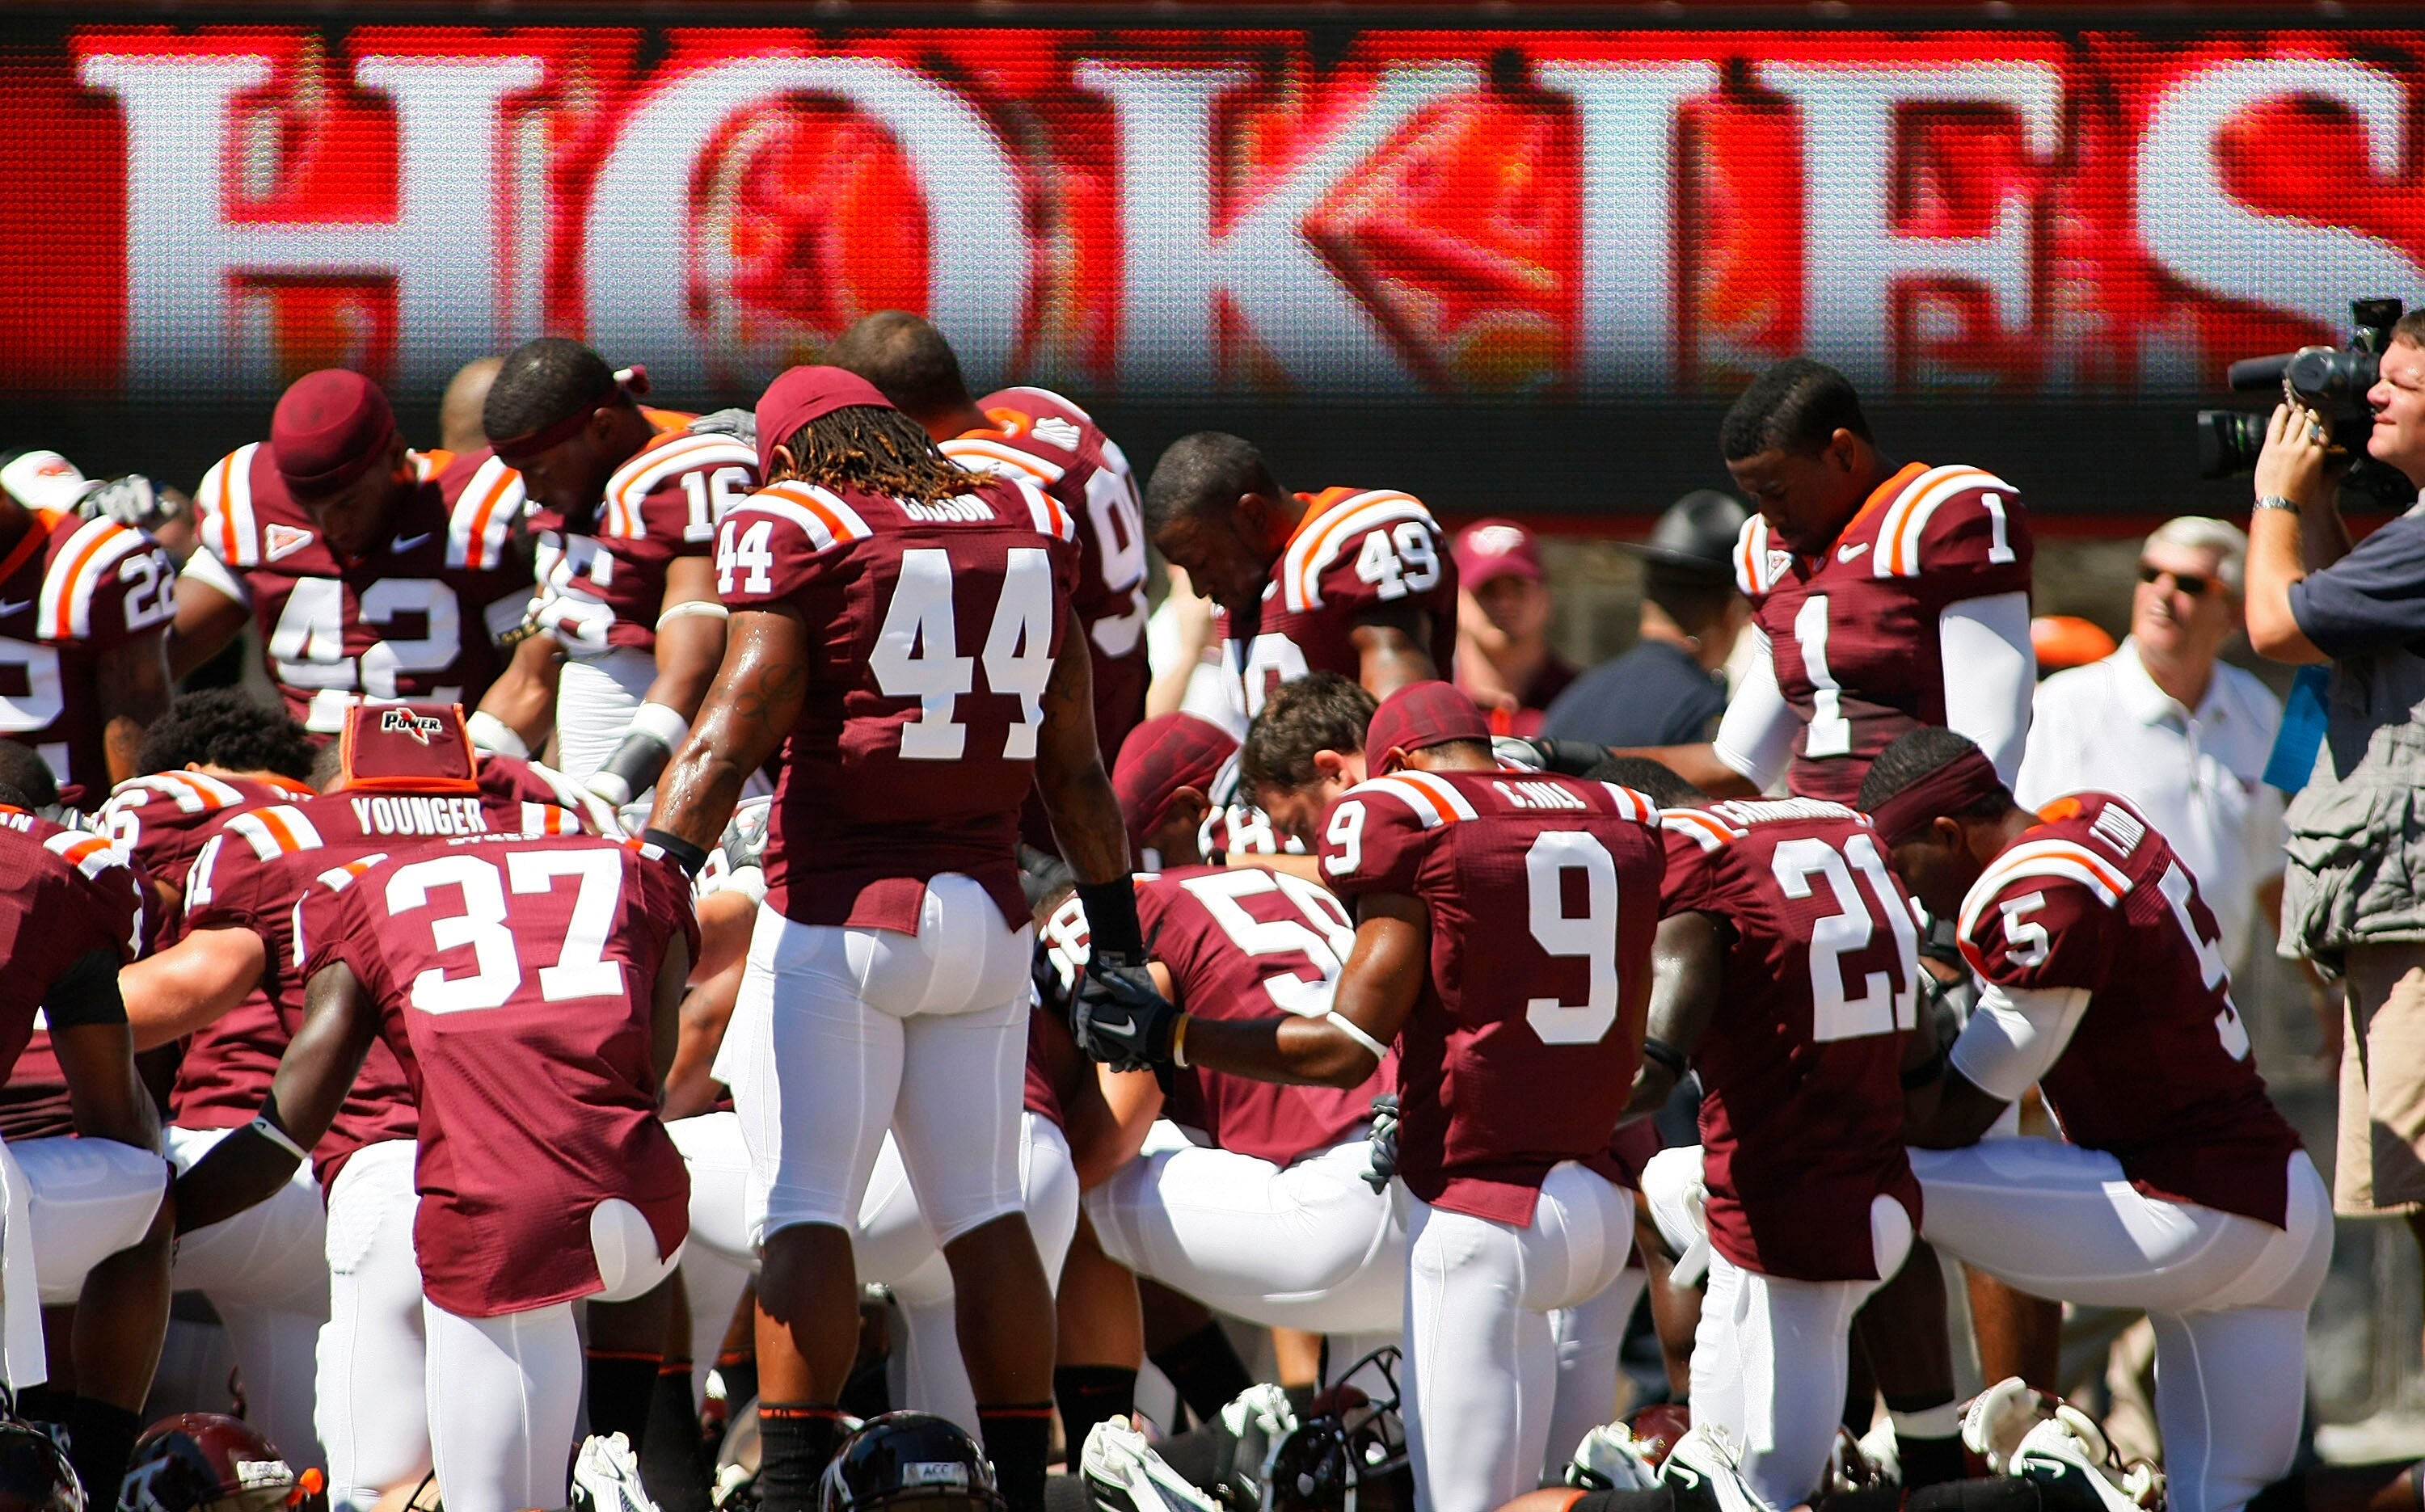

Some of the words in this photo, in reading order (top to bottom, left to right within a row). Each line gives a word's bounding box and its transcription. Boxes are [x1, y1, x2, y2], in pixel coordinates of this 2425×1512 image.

[77, 53, 2425, 400] HOKIES
[715, 520, 774, 594] 44
[1355, 522, 1440, 601] 49
[1980, 493, 2016, 564] 1
[268, 576, 462, 732] 42
[868, 548, 1054, 760] 44
[1794, 595, 1851, 758] 1
[351, 797, 487, 836] YOUNGER
[1324, 799, 1367, 876] 9
[385, 845, 626, 1015] 37
[1525, 831, 1618, 1045] 9
[1772, 833, 1919, 1043] 21
[1998, 891, 2050, 968] 5
